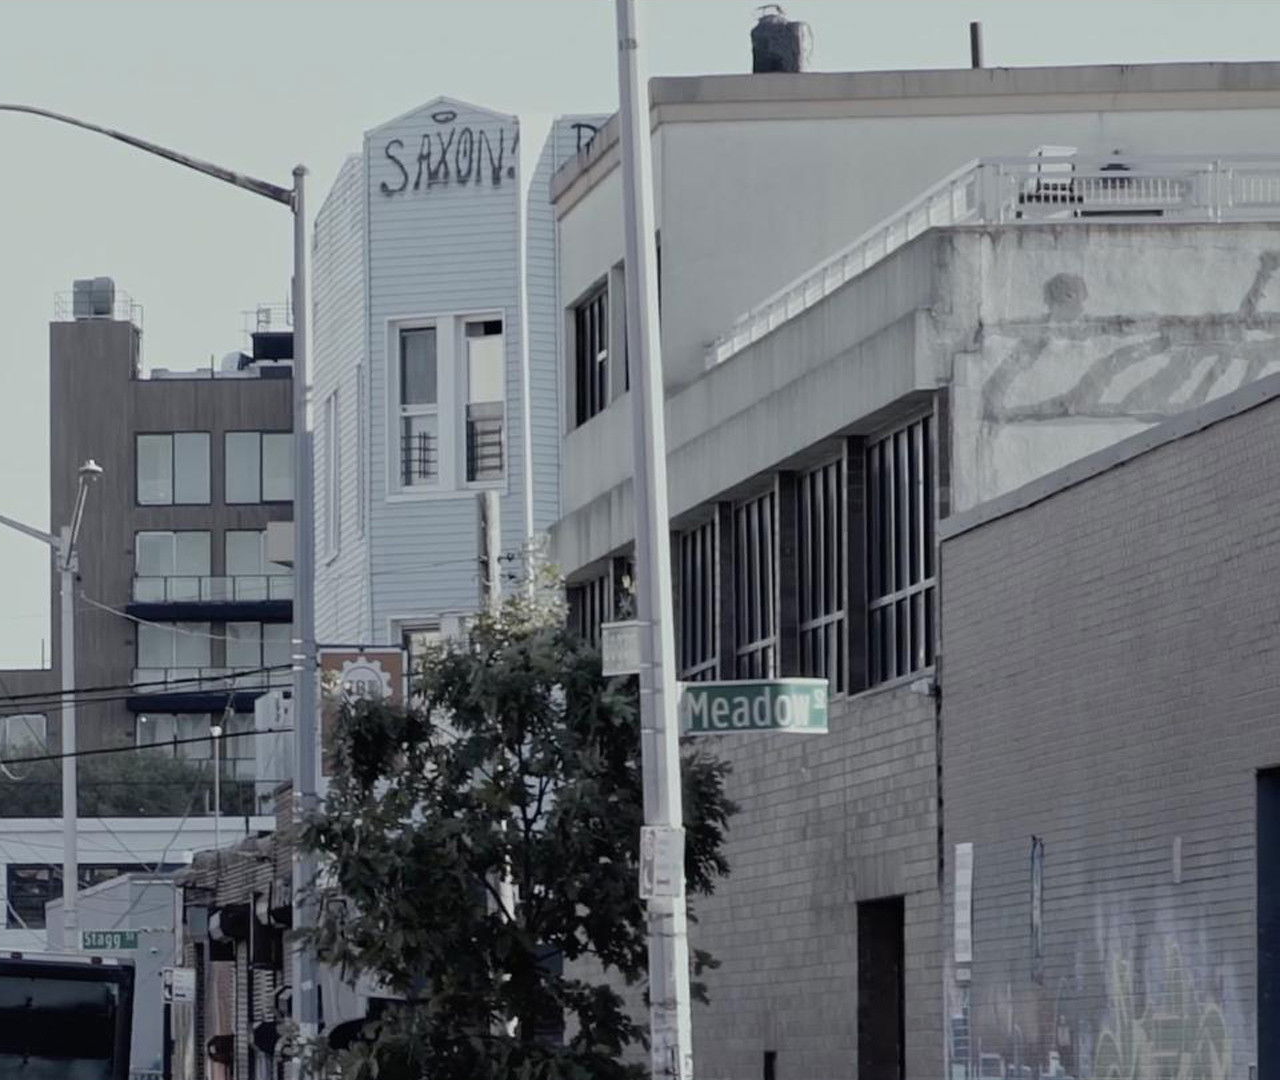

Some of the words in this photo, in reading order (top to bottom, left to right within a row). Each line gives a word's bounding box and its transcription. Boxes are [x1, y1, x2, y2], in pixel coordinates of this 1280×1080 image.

[380, 126, 519, 197] SAXON!
[687, 686, 811, 730] Meadow
[84, 931, 122, 949] Stagg
